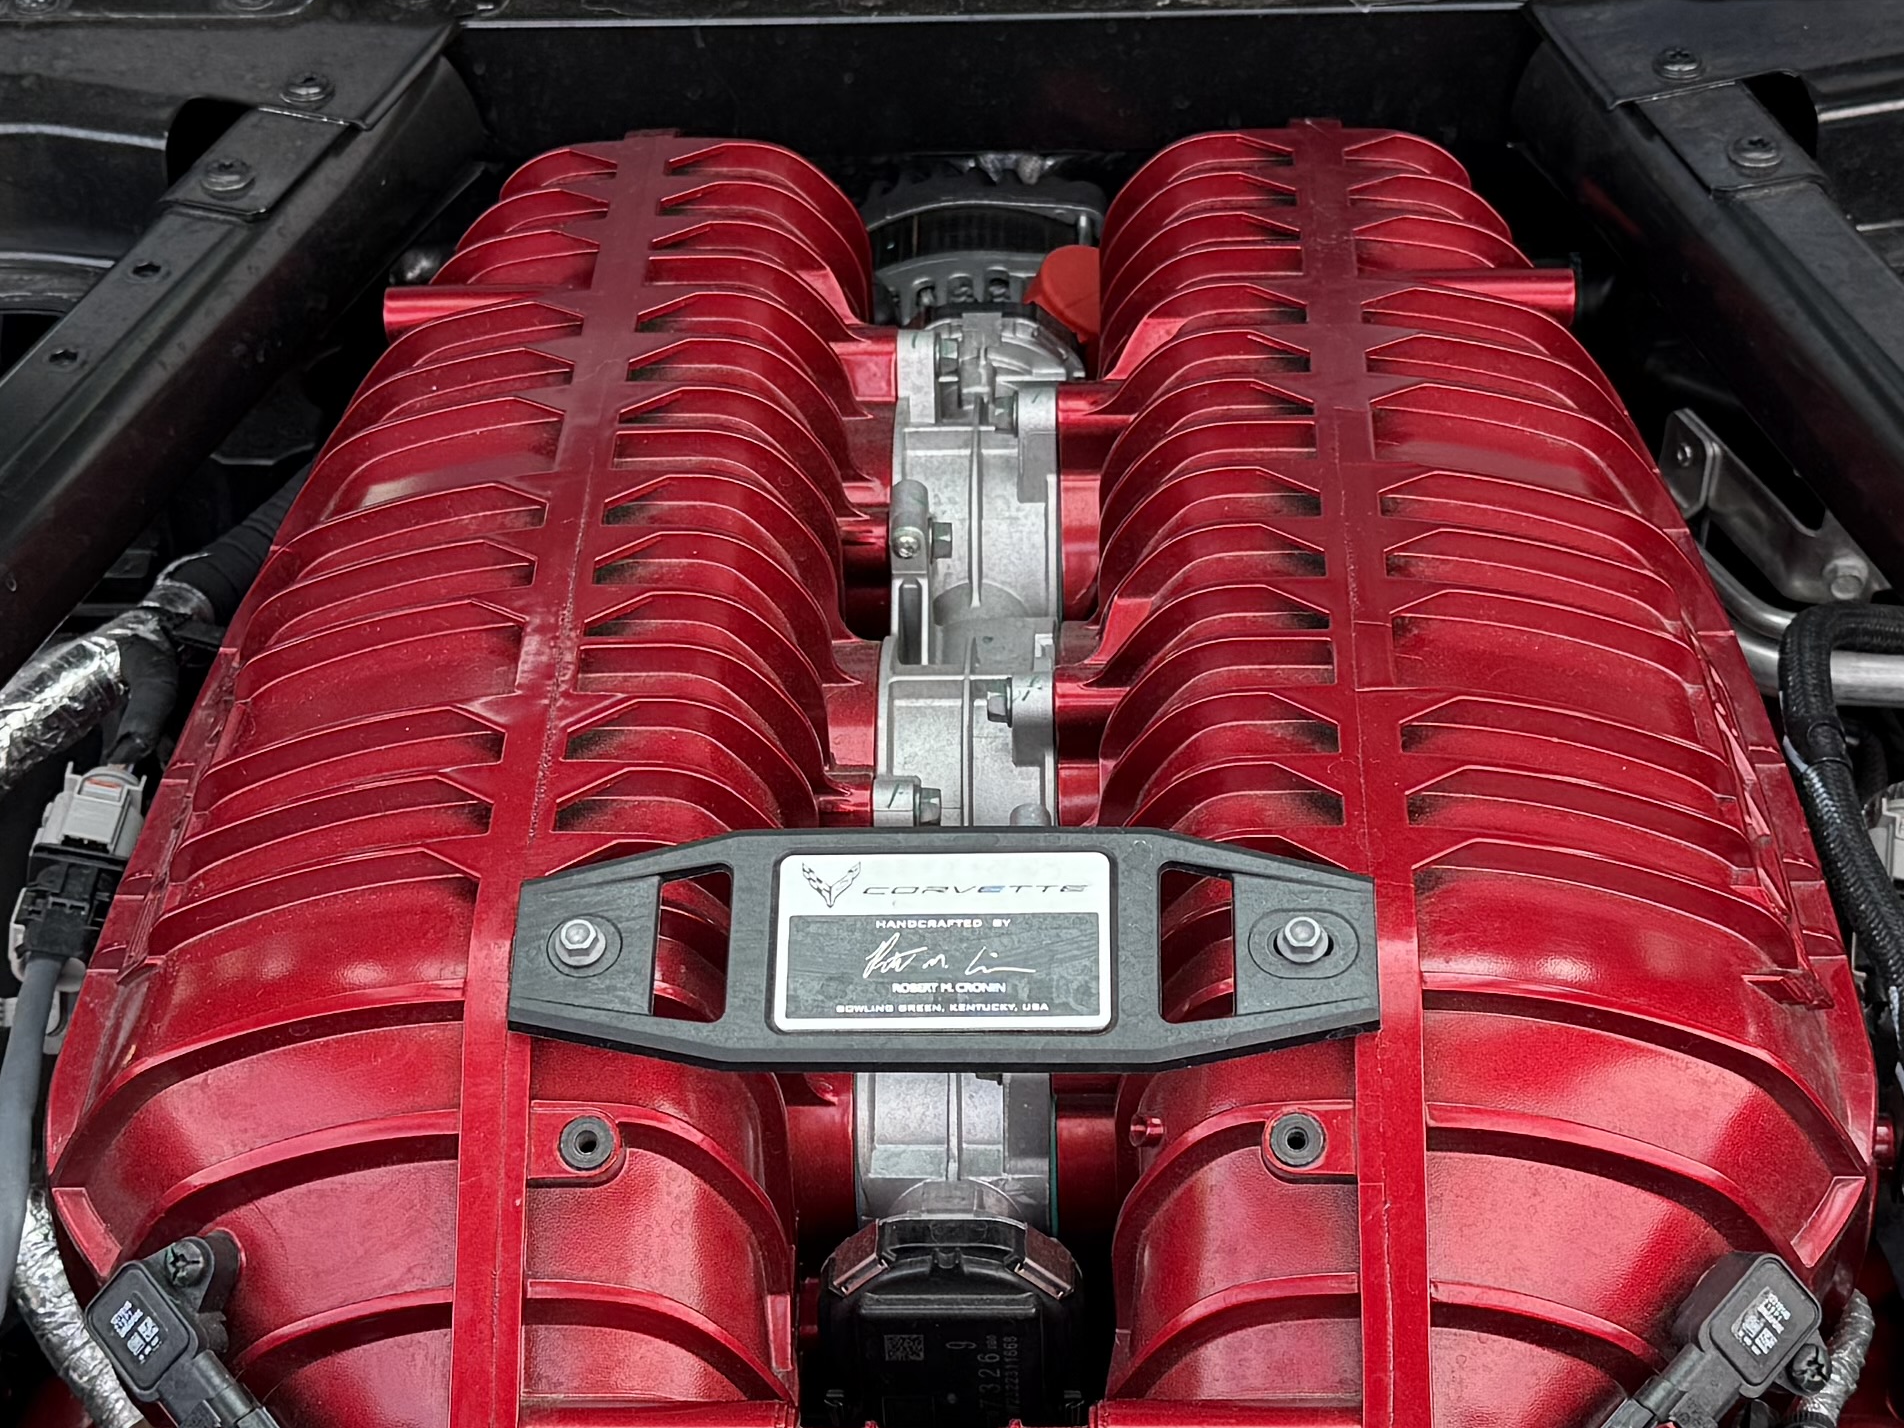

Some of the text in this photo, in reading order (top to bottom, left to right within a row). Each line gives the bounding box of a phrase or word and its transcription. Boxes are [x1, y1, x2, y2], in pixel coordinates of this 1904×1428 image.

[863, 883, 1089, 895] CORVETTE
[876, 918, 1012, 930] HANDCRAFTED BY
[892, 981, 939, 994] ROBERT
[955, 981, 1007, 994] CRONIN
[835, 1004, 894, 1014] BOWLING
[1022, 1003, 1050, 1013] USA
